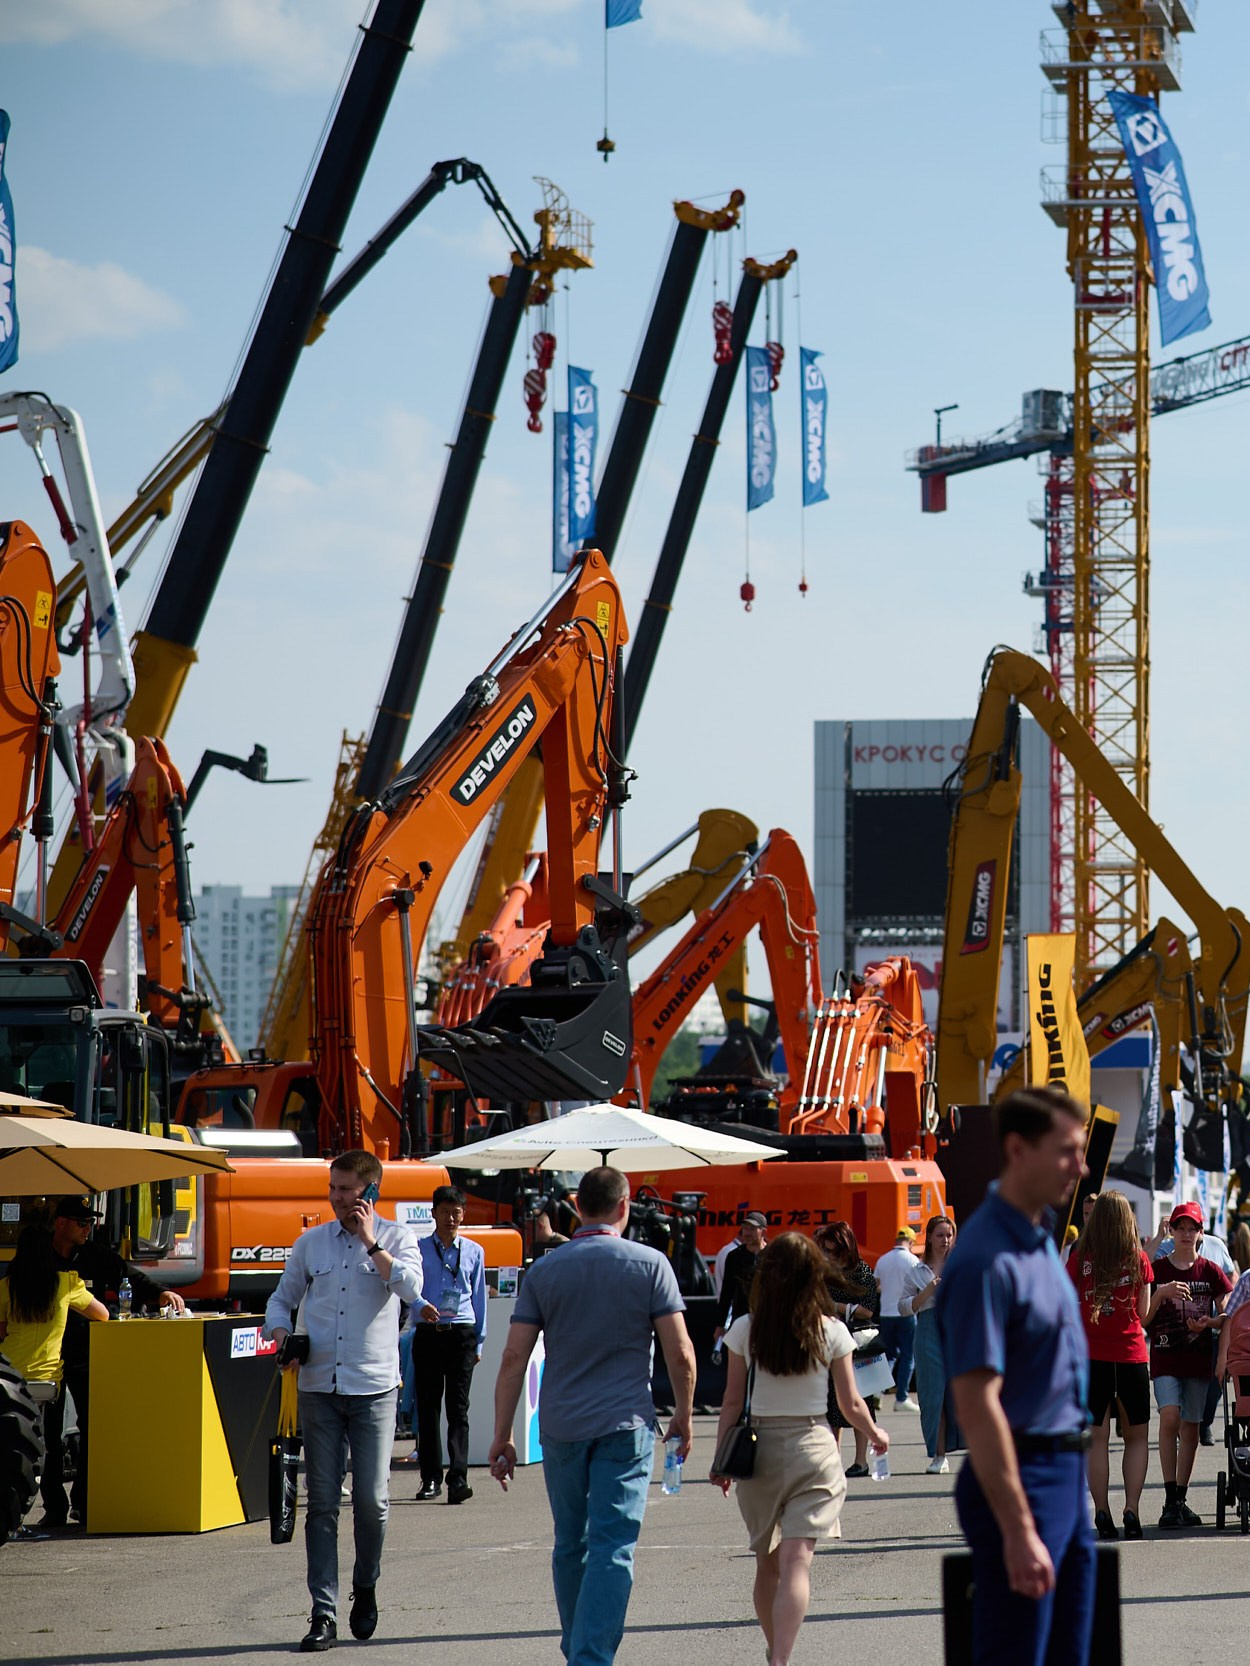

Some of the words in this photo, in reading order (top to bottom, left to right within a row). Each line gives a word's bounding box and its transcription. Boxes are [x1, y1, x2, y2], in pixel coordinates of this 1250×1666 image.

[1142, 161, 1198, 301] XCMG
[573, 421, 595, 519] XCMG
[751, 401, 772, 489] XCMG
[806, 400, 824, 484] XCMG
[459, 704, 534, 800] DEVELON
[853, 744, 946, 764] КРОКУС
[70, 873, 103, 940] DEVELON
[975, 871, 991, 920] XCMG
[232, 1334, 255, 1352] АВТО
